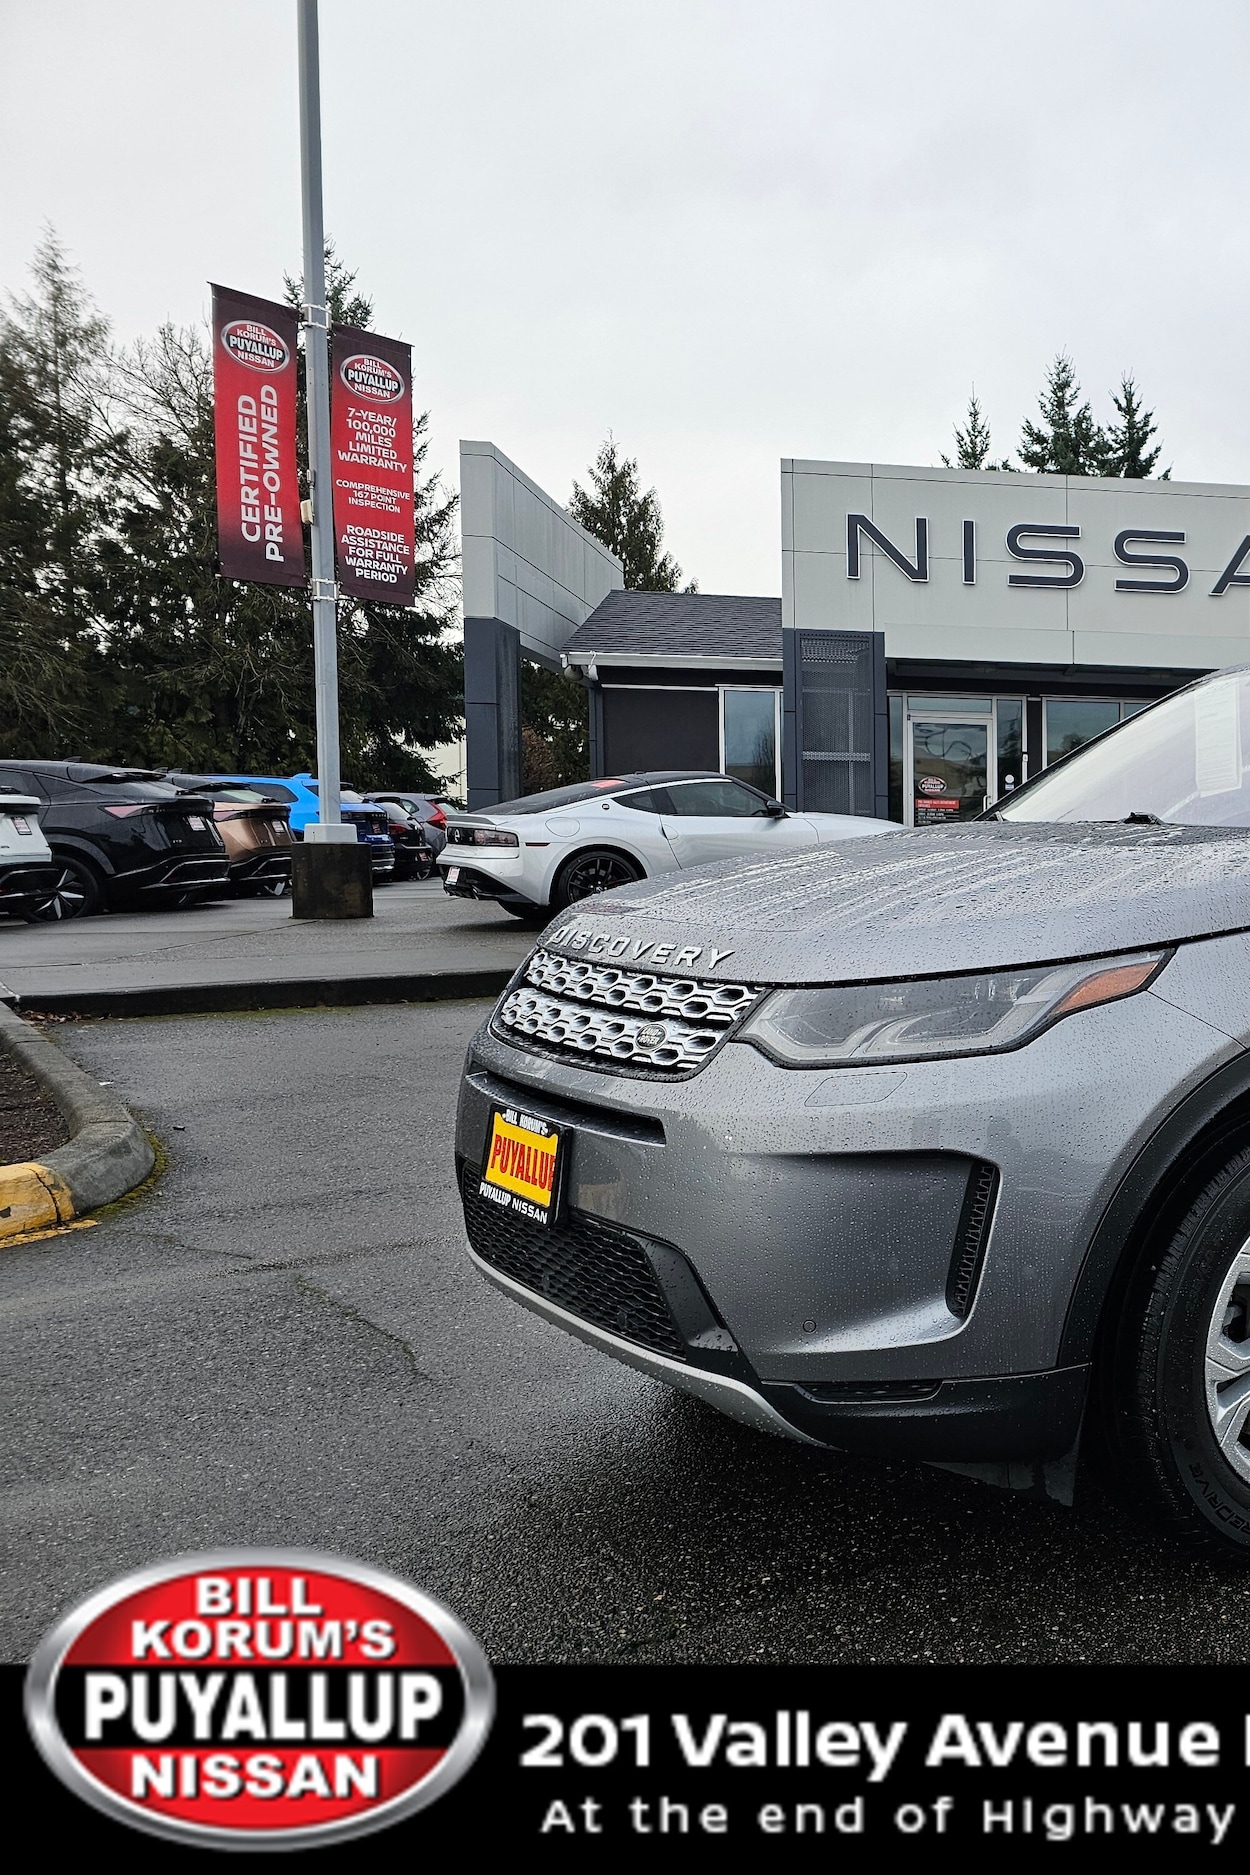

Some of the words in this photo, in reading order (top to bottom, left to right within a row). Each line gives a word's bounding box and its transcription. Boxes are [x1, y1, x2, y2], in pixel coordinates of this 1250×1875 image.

[237, 329, 276, 346] KORUM'S
[247, 324, 266, 336] BILL
[230, 335, 283, 360] PUYALLUP
[238, 350, 274, 367] NISSAN
[364, 358, 381, 369] BILL
[348, 369, 398, 391] PUYALLUP
[354, 363, 392, 378] KORUM'S
[354, 383, 390, 398] NISSAN
[348, 407, 397, 427] 7-YEAR/
[346, 419, 396, 438] 100,000
[355, 431, 392, 448] MILES
[349, 441, 397, 460] LIMITED
[238, 395, 261, 543] CERTIFIED
[338, 450, 407, 473] WARRANTY
[261, 385, 284, 562] PRE-OWNED
[336, 479, 410, 500] COMPREHENSIVE
[353, 490, 369, 499] 167
[371, 493, 396, 504] POINT
[348, 497, 400, 513] INSPECTION
[346, 524, 404, 544] ROADSIDE
[341, 535, 410, 555] ASSISTANCE
[348, 546, 373, 558] FOR
[376, 551, 402, 563] FULL
[345, 556, 408, 575] WARRANTY
[355, 568, 397, 583] PERIOD
[551, 925, 735, 969] DISCOVERY
[479, 1182, 511, 1206] PUYALLUP
[512, 1198, 548, 1224] NISSAN
